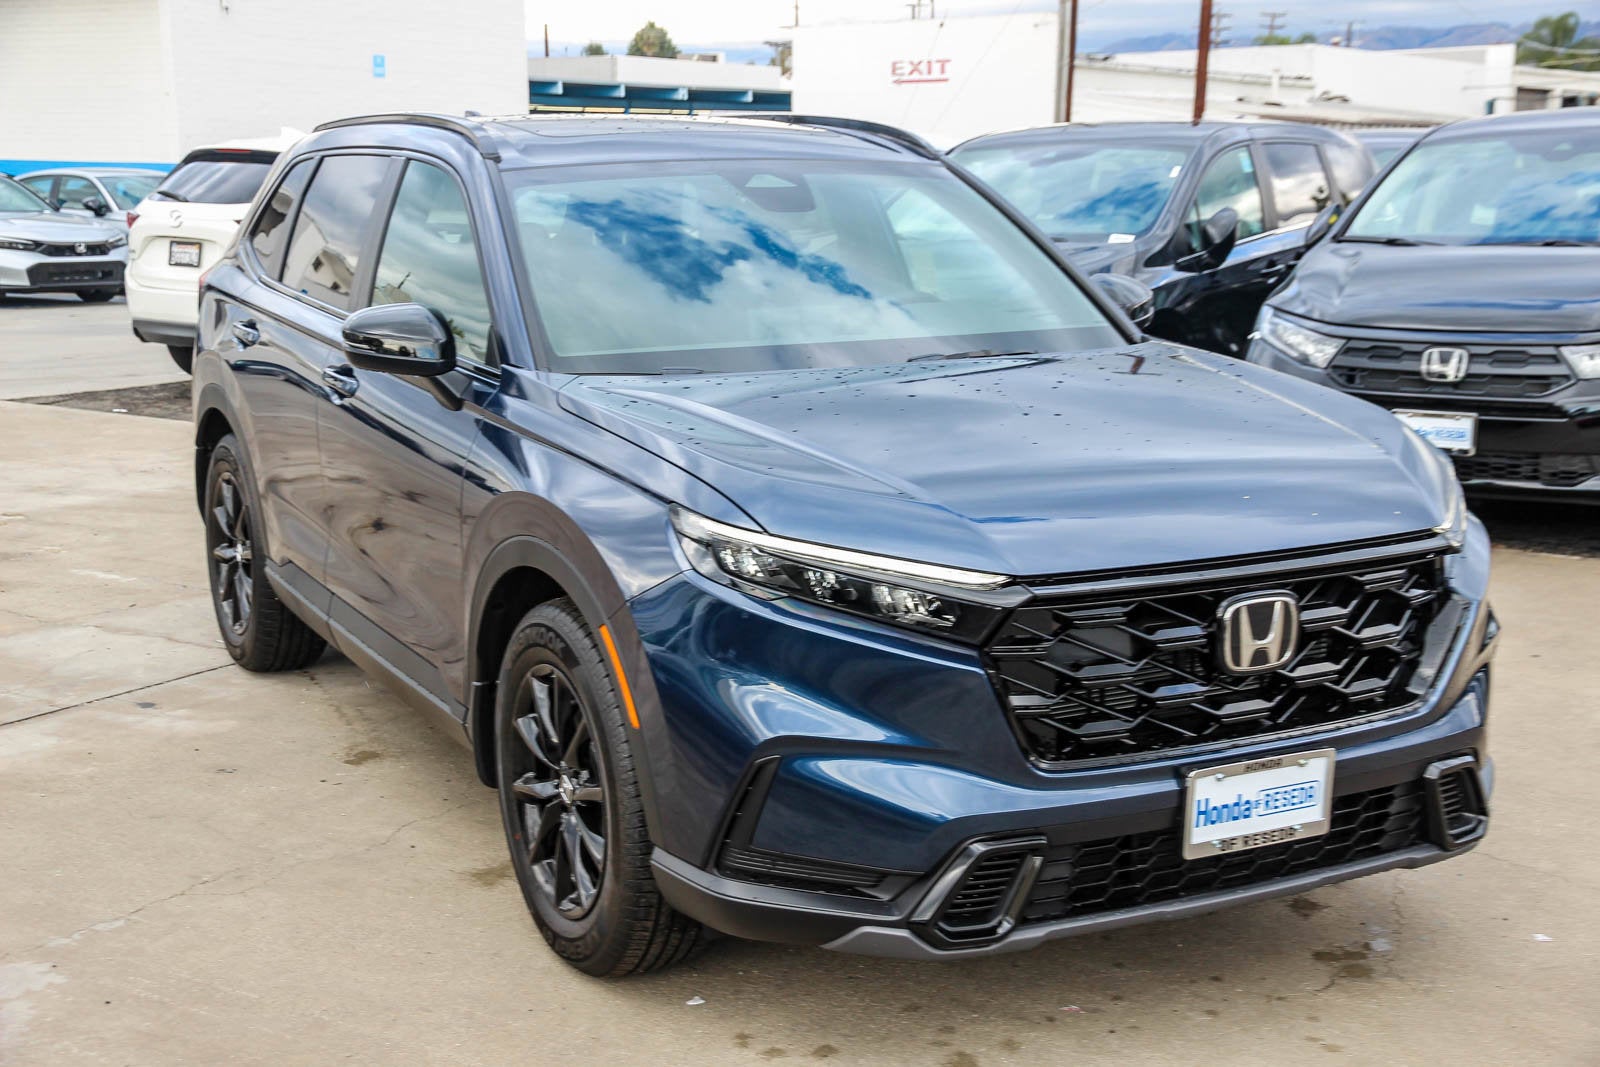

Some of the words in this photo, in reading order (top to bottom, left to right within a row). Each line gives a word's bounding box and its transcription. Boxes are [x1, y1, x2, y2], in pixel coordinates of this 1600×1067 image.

[891, 59, 952, 76] EXIT
[1194, 794, 1252, 828] Honda
[1264, 785, 1315, 811] RESEDA
[1219, 837, 1237, 852] OF
[1243, 826, 1297, 846] RESEDA
